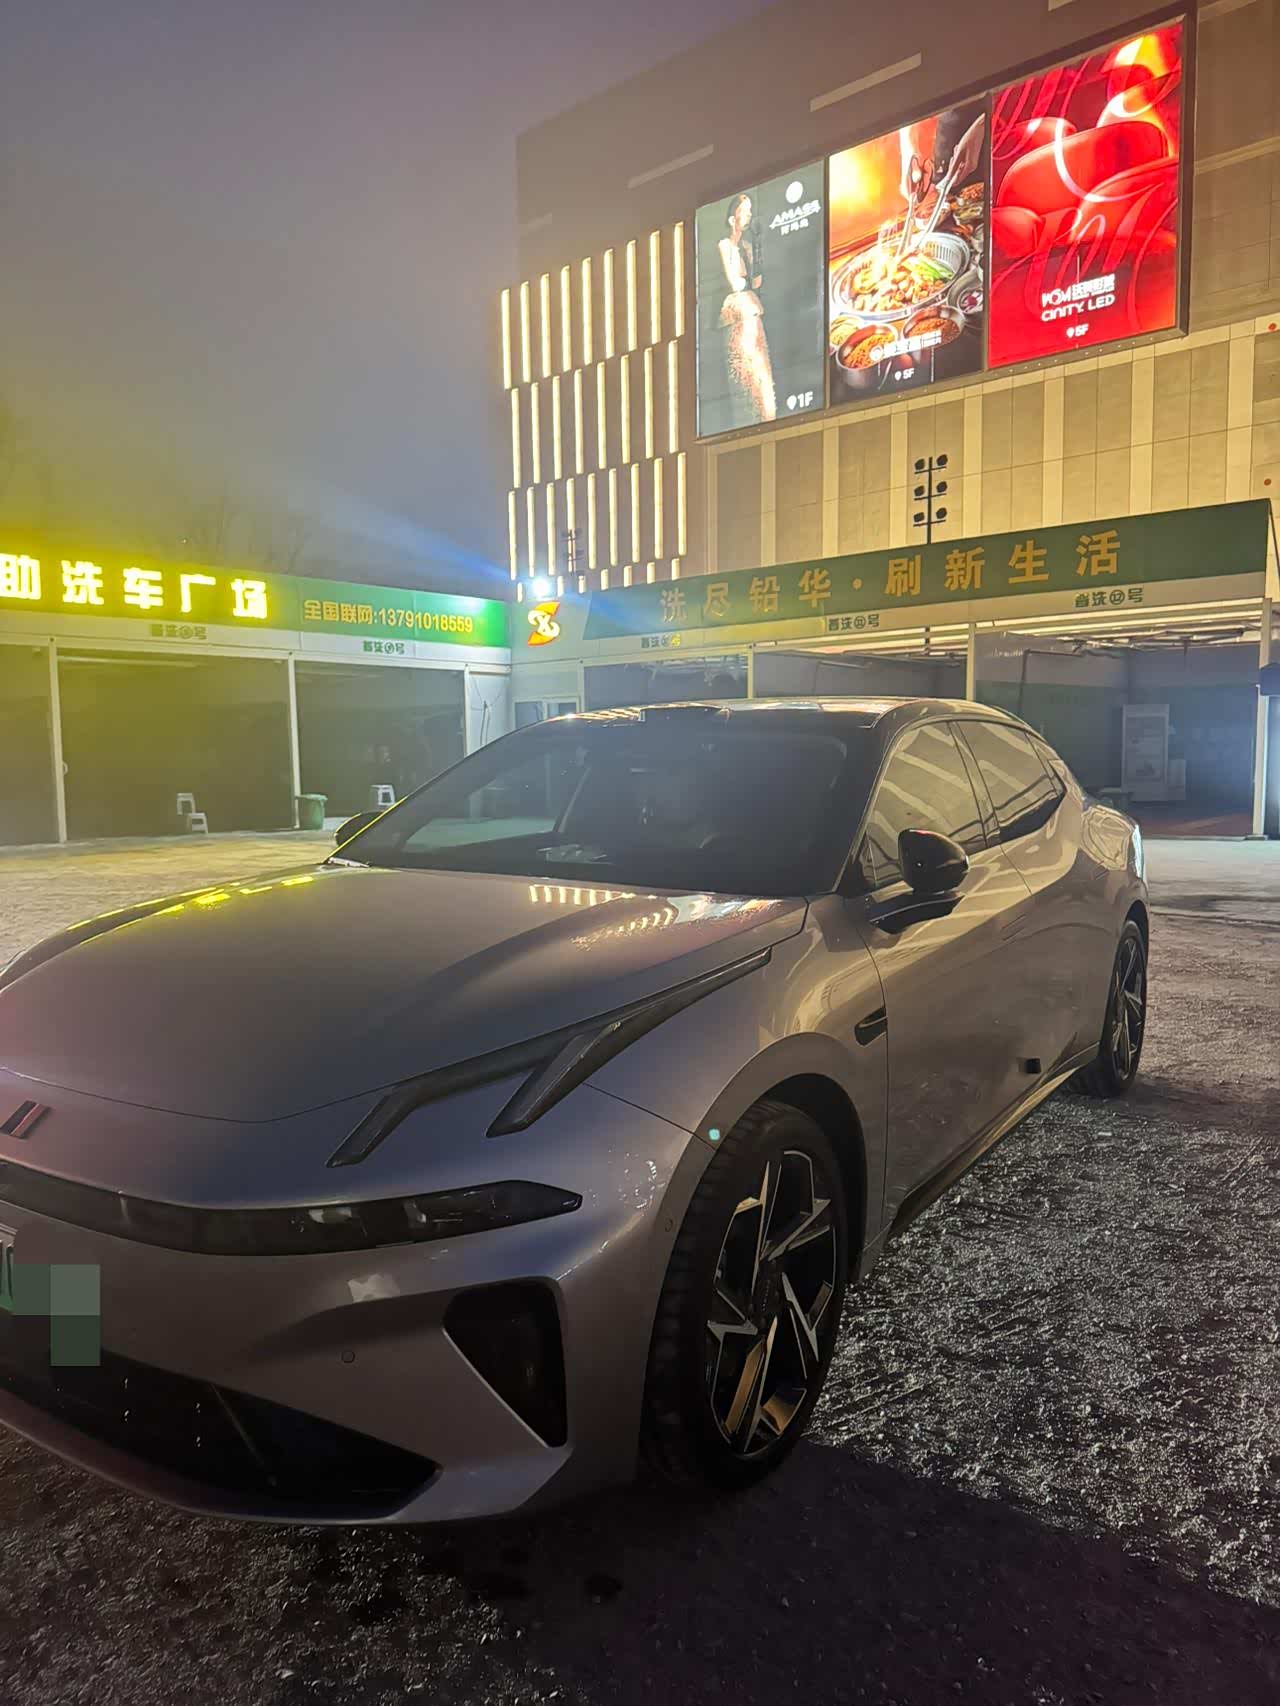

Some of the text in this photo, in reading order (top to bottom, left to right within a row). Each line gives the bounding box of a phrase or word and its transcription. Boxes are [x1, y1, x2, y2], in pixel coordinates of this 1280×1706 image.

[1087, 293, 1116, 311] LED
[797, 391, 813, 408] 1F
[0, 553, 268, 619] 助洗车广场
[303, 600, 474, 633] 全国联网:13791018559
